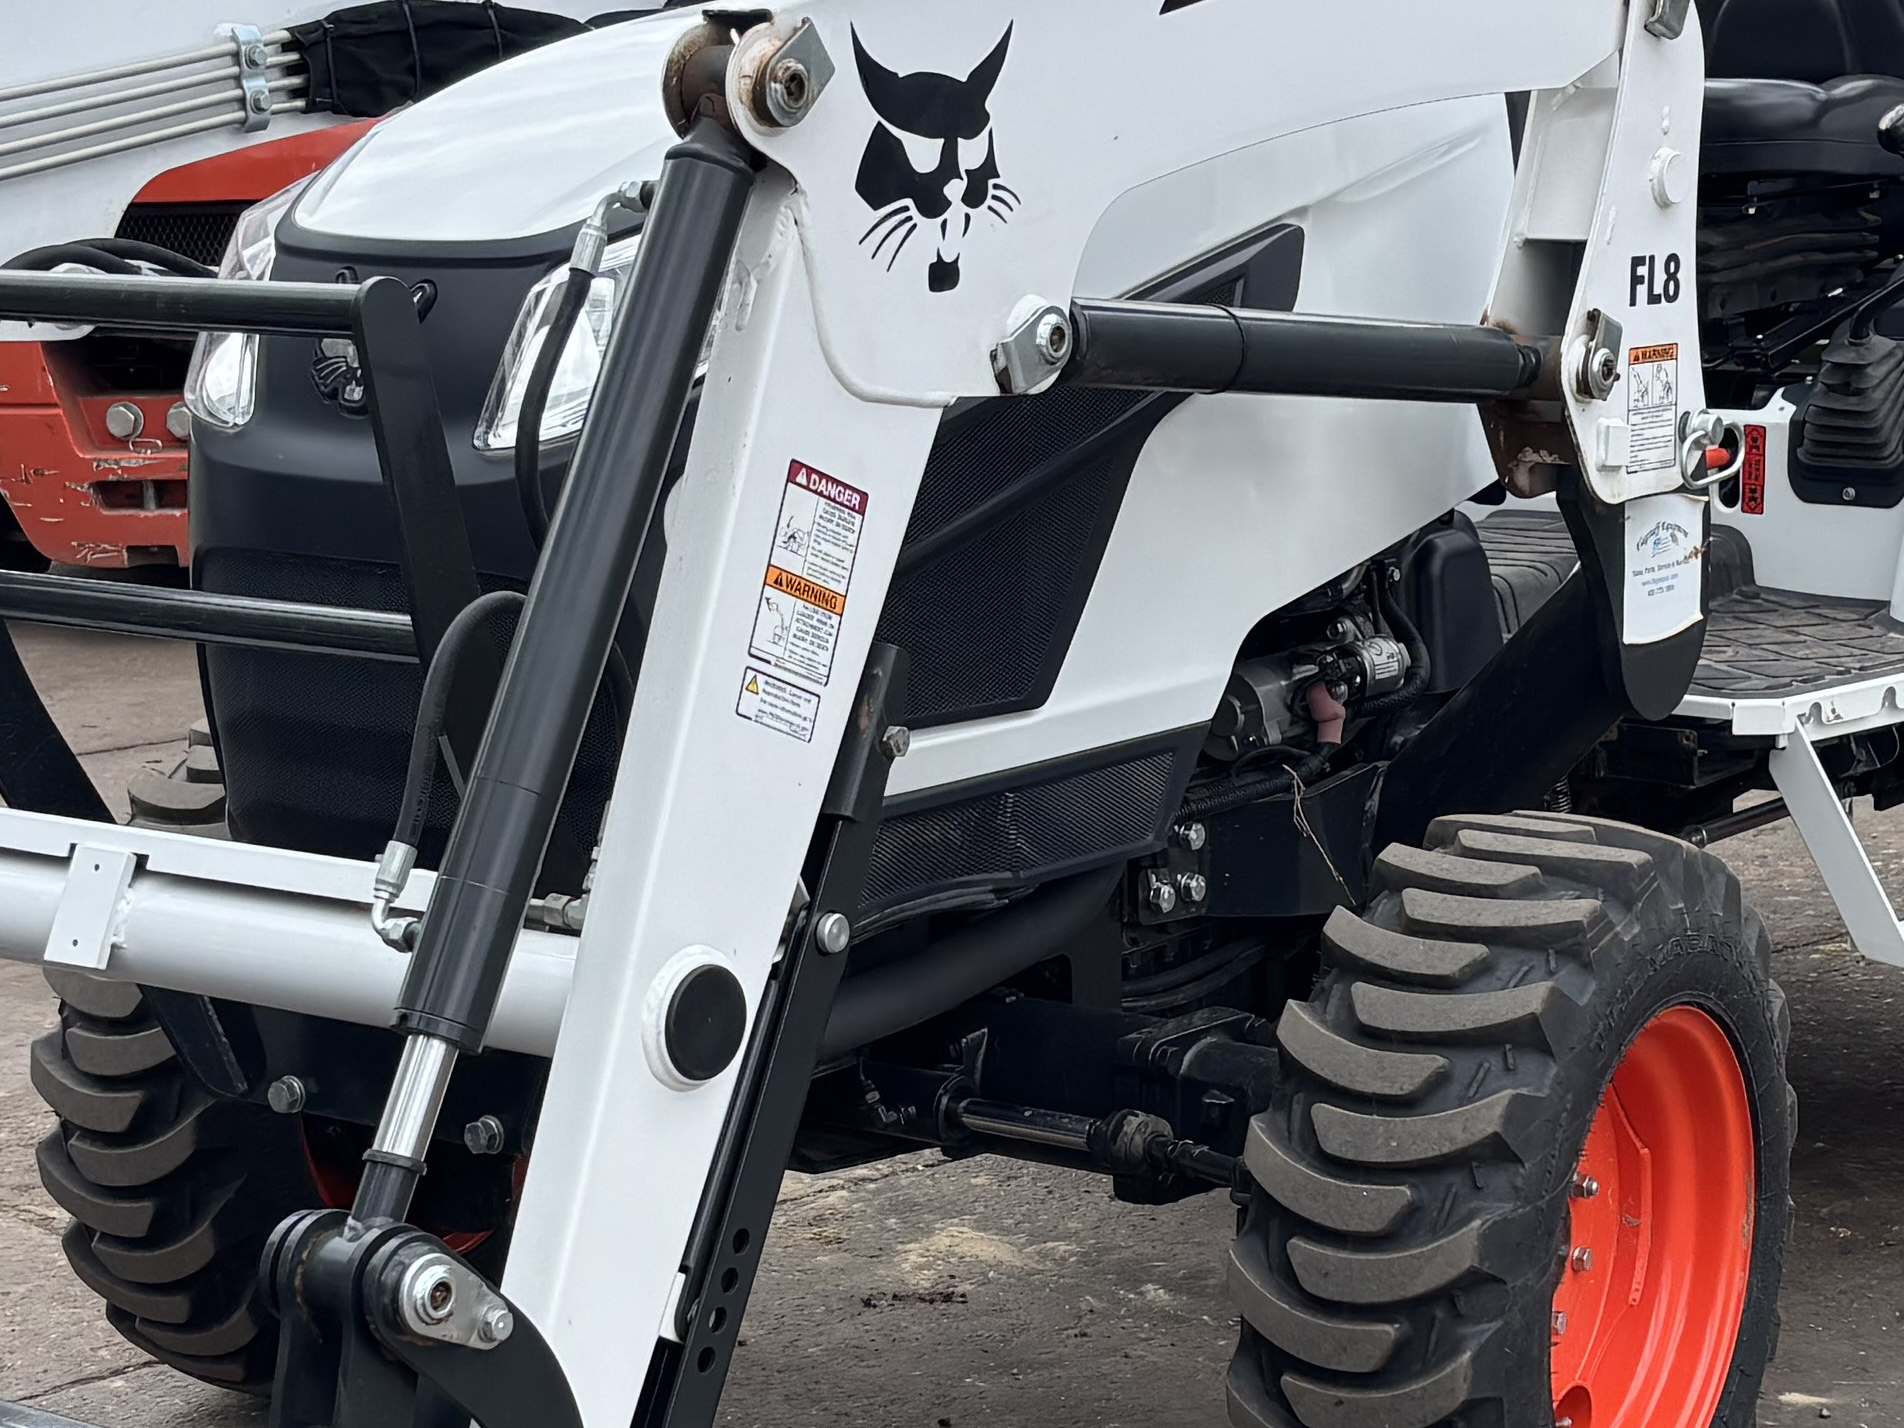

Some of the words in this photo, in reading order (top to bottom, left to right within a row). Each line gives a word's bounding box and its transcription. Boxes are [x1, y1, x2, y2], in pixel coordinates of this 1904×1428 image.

[1628, 252, 1681, 307] FL8
[1641, 347, 1674, 361] WARNING
[809, 472, 862, 510] DANGER
[784, 574, 838, 611] WARNING
